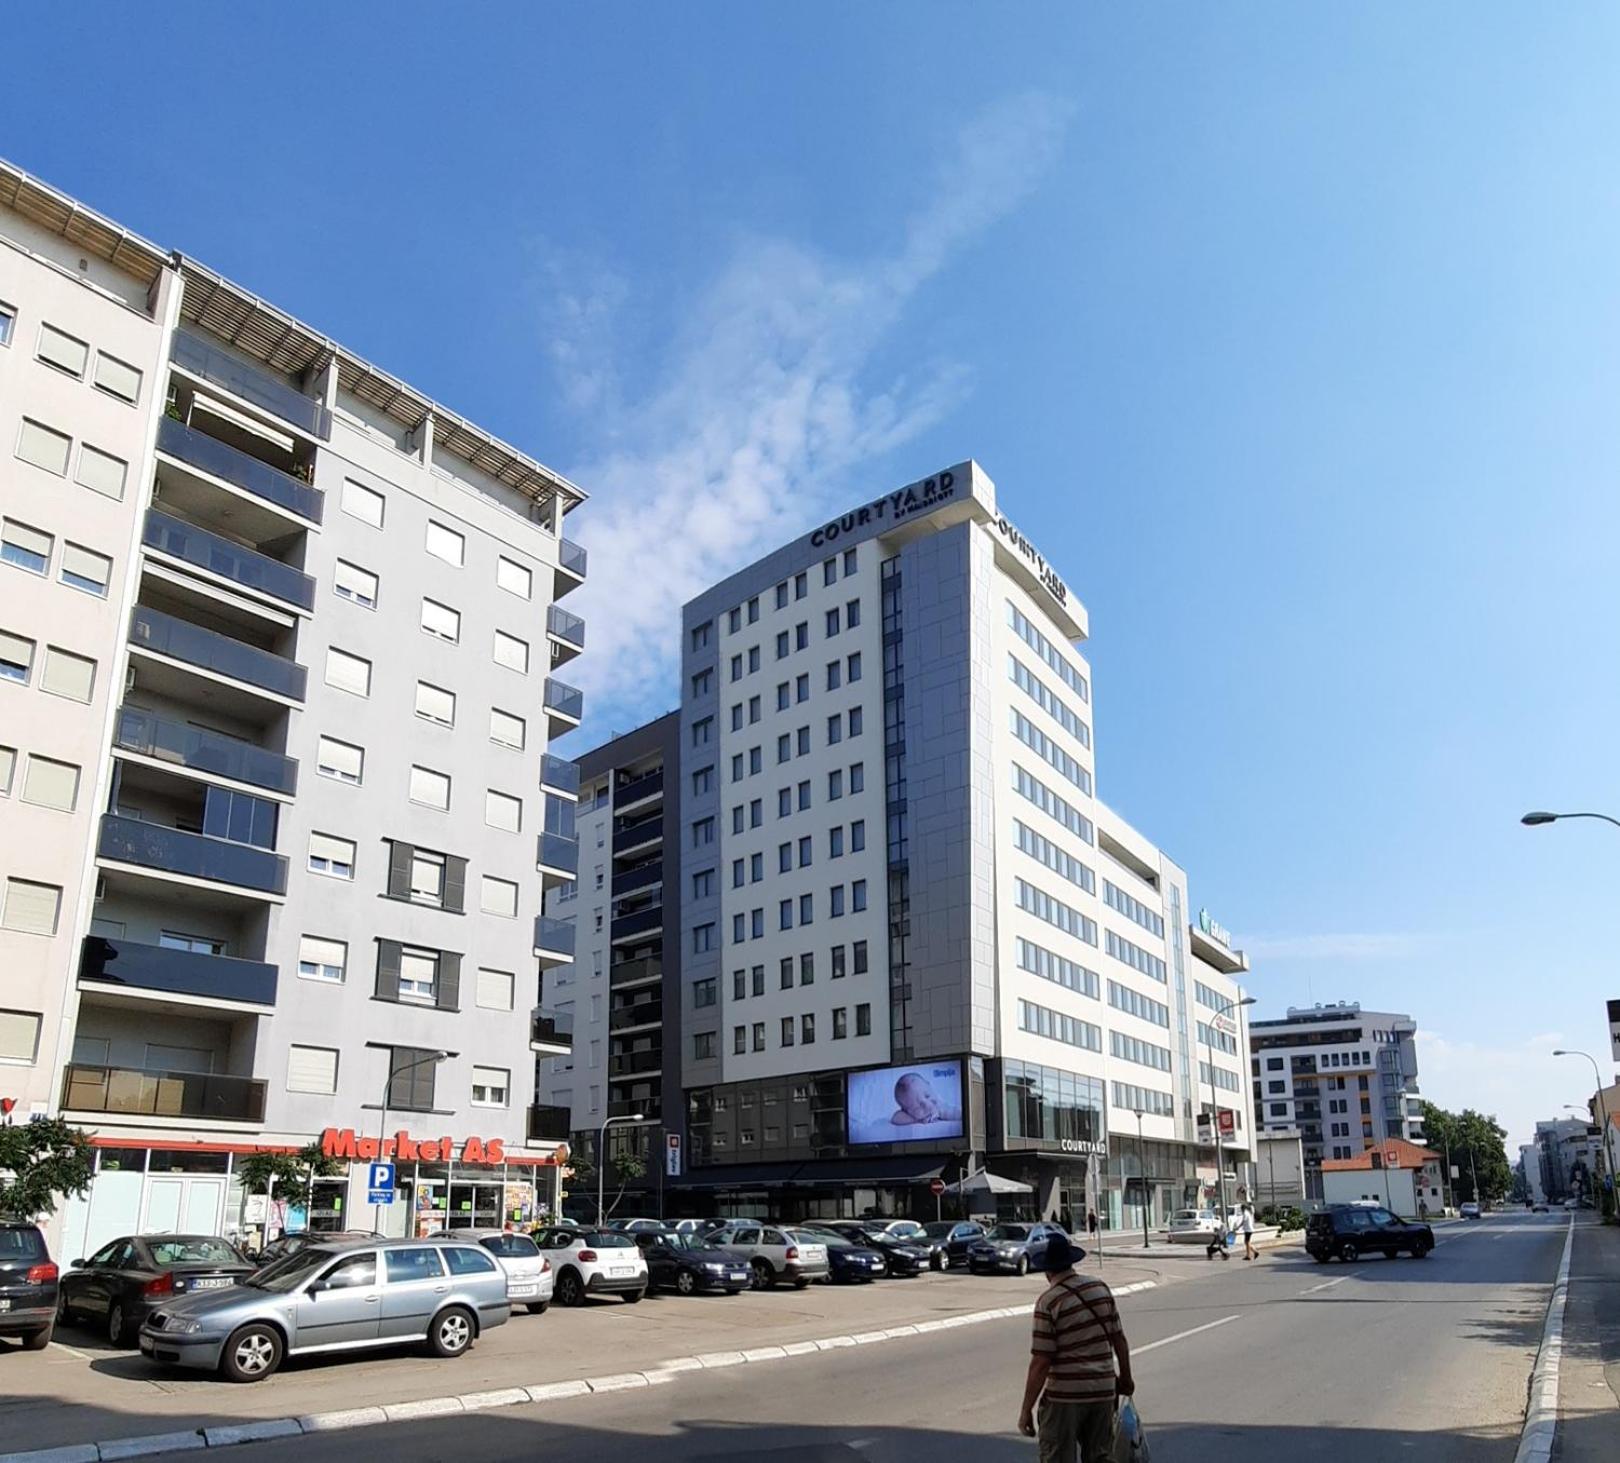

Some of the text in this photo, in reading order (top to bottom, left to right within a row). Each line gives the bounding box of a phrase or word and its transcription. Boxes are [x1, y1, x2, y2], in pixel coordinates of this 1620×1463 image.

[810, 471, 955, 548] COURTYARD
[322, 1127, 505, 1166] Market AS
[1061, 1139, 1106, 1154] COURTYARD
[374, 1166, 390, 1187] P
